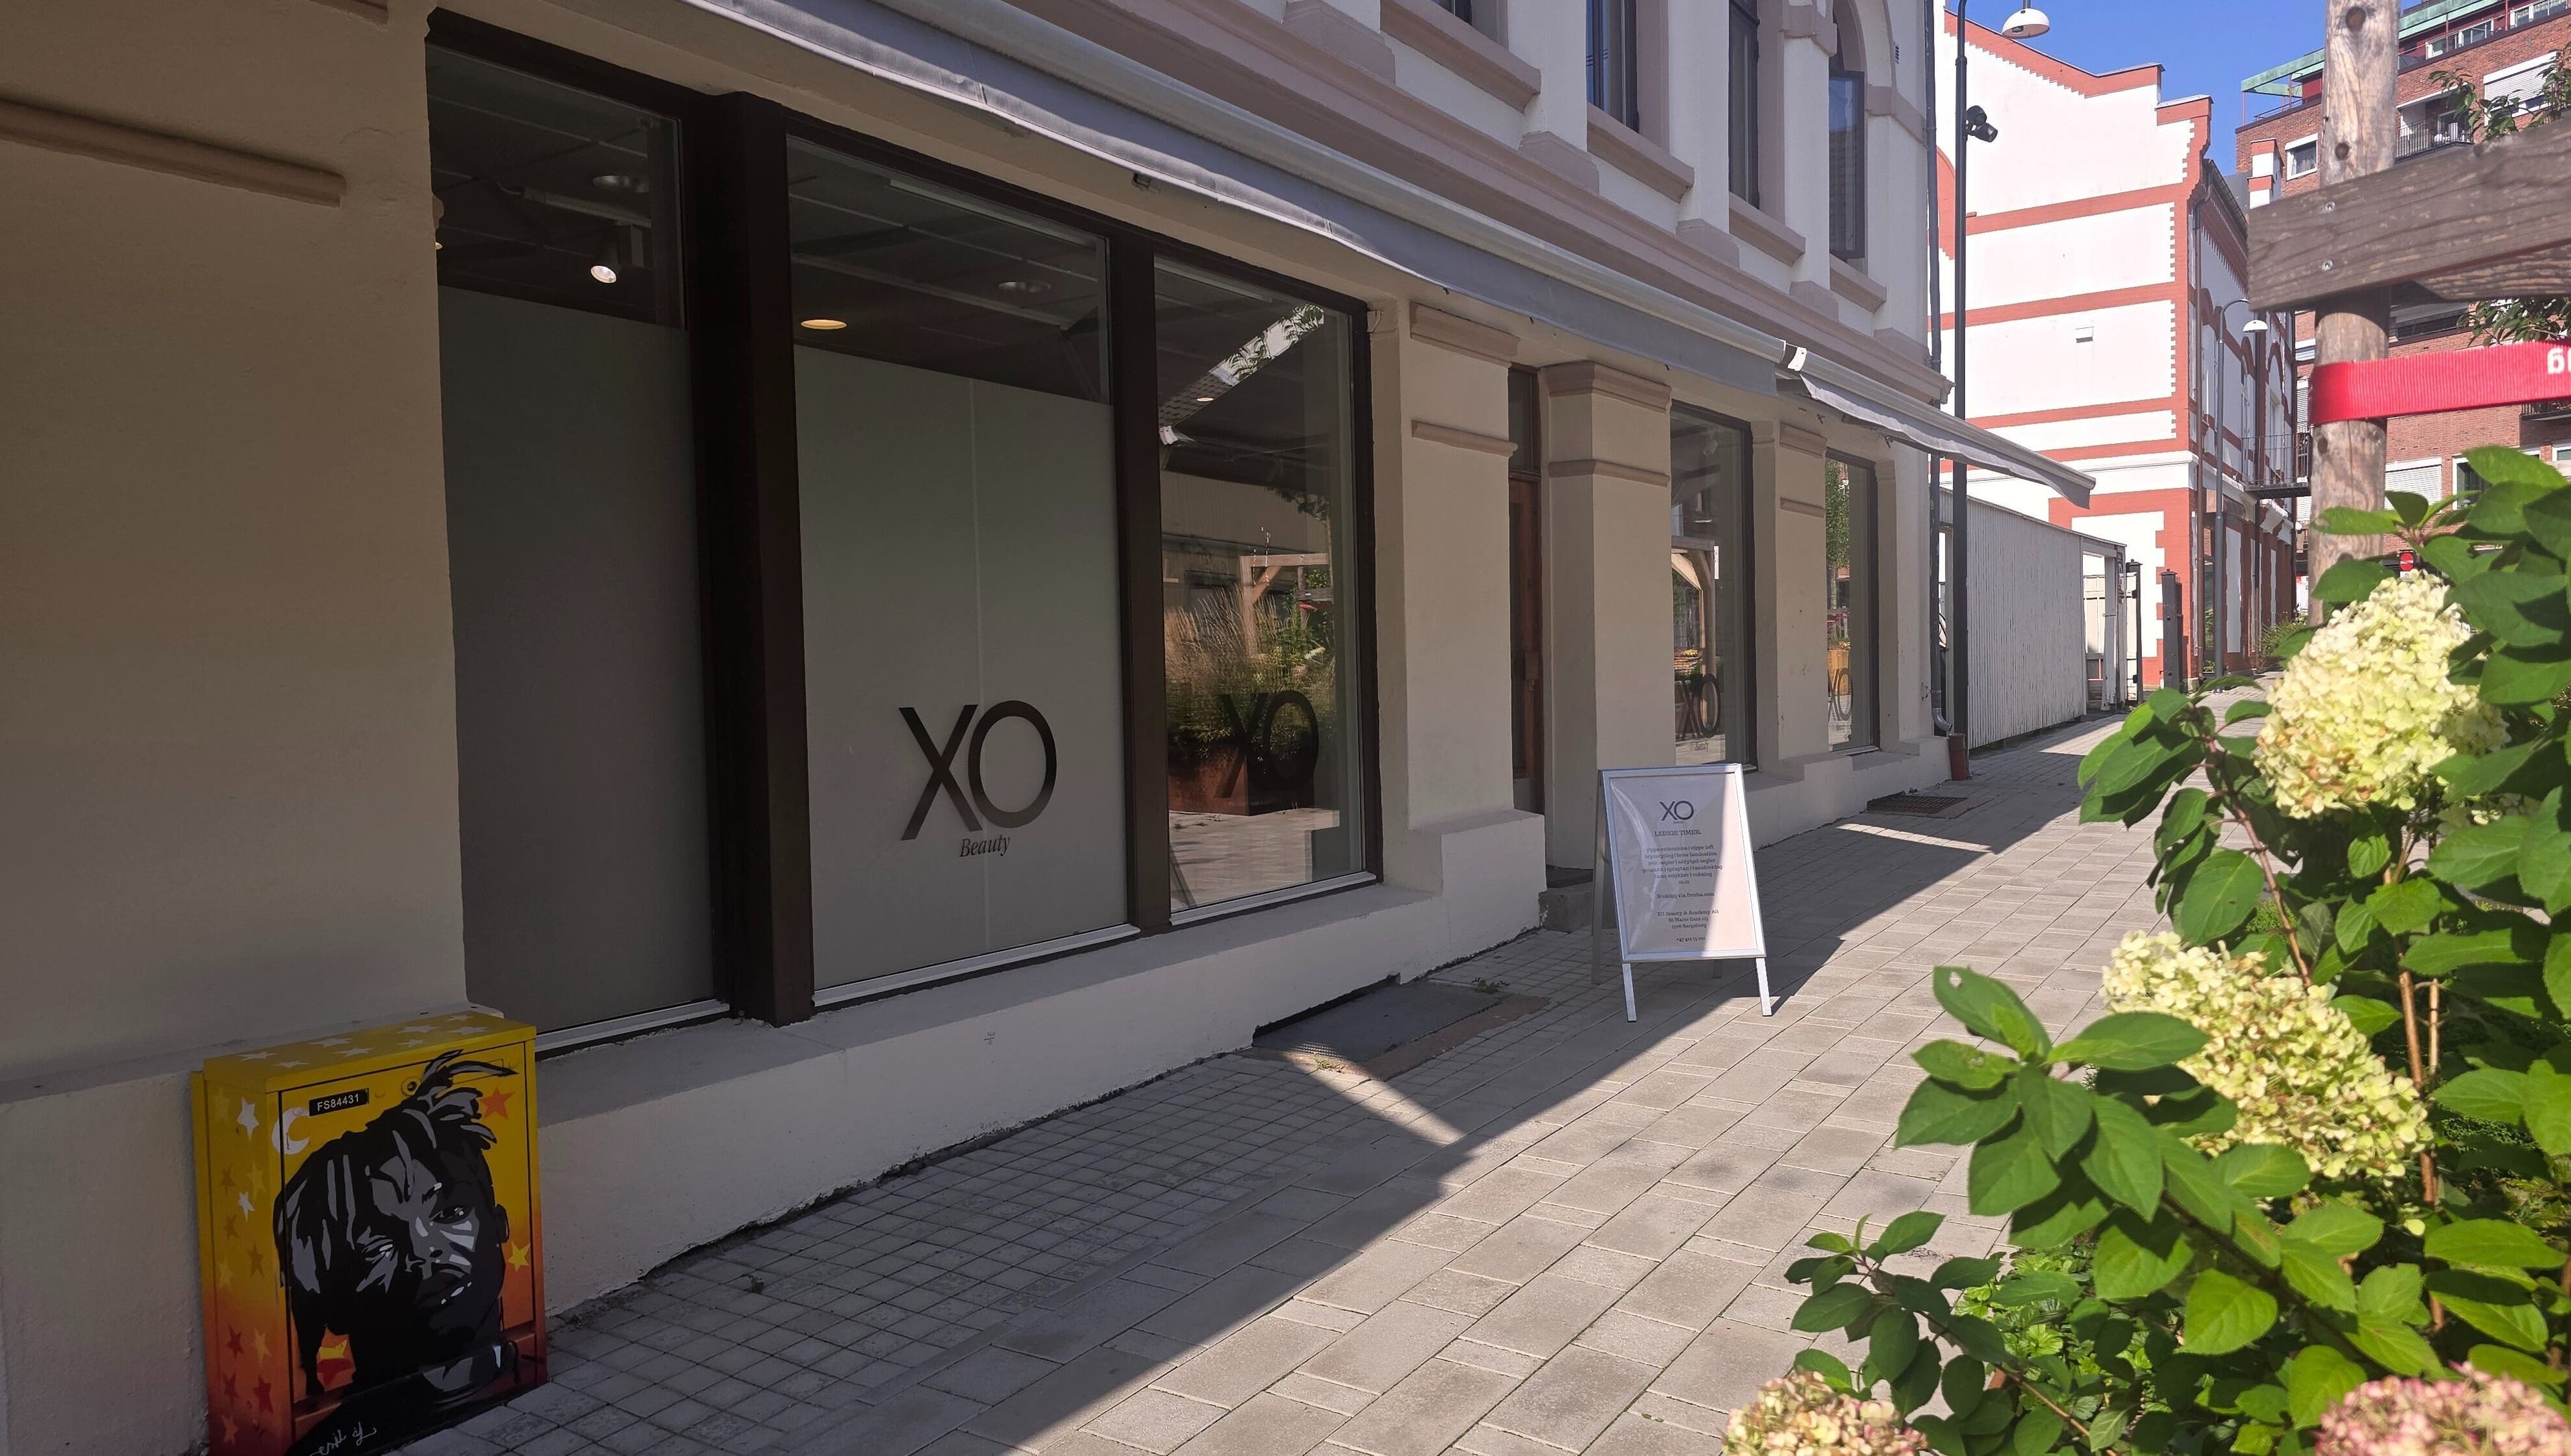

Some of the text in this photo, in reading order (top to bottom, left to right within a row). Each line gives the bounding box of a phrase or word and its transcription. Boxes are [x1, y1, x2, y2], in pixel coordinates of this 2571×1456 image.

[1213, 690, 1320, 798] XO
[899, 700, 1057, 841] XO
[1659, 800, 1694, 821] XO
[959, 834, 1010, 857] Beauty
[317, 1093, 359, 1112] FS84431
